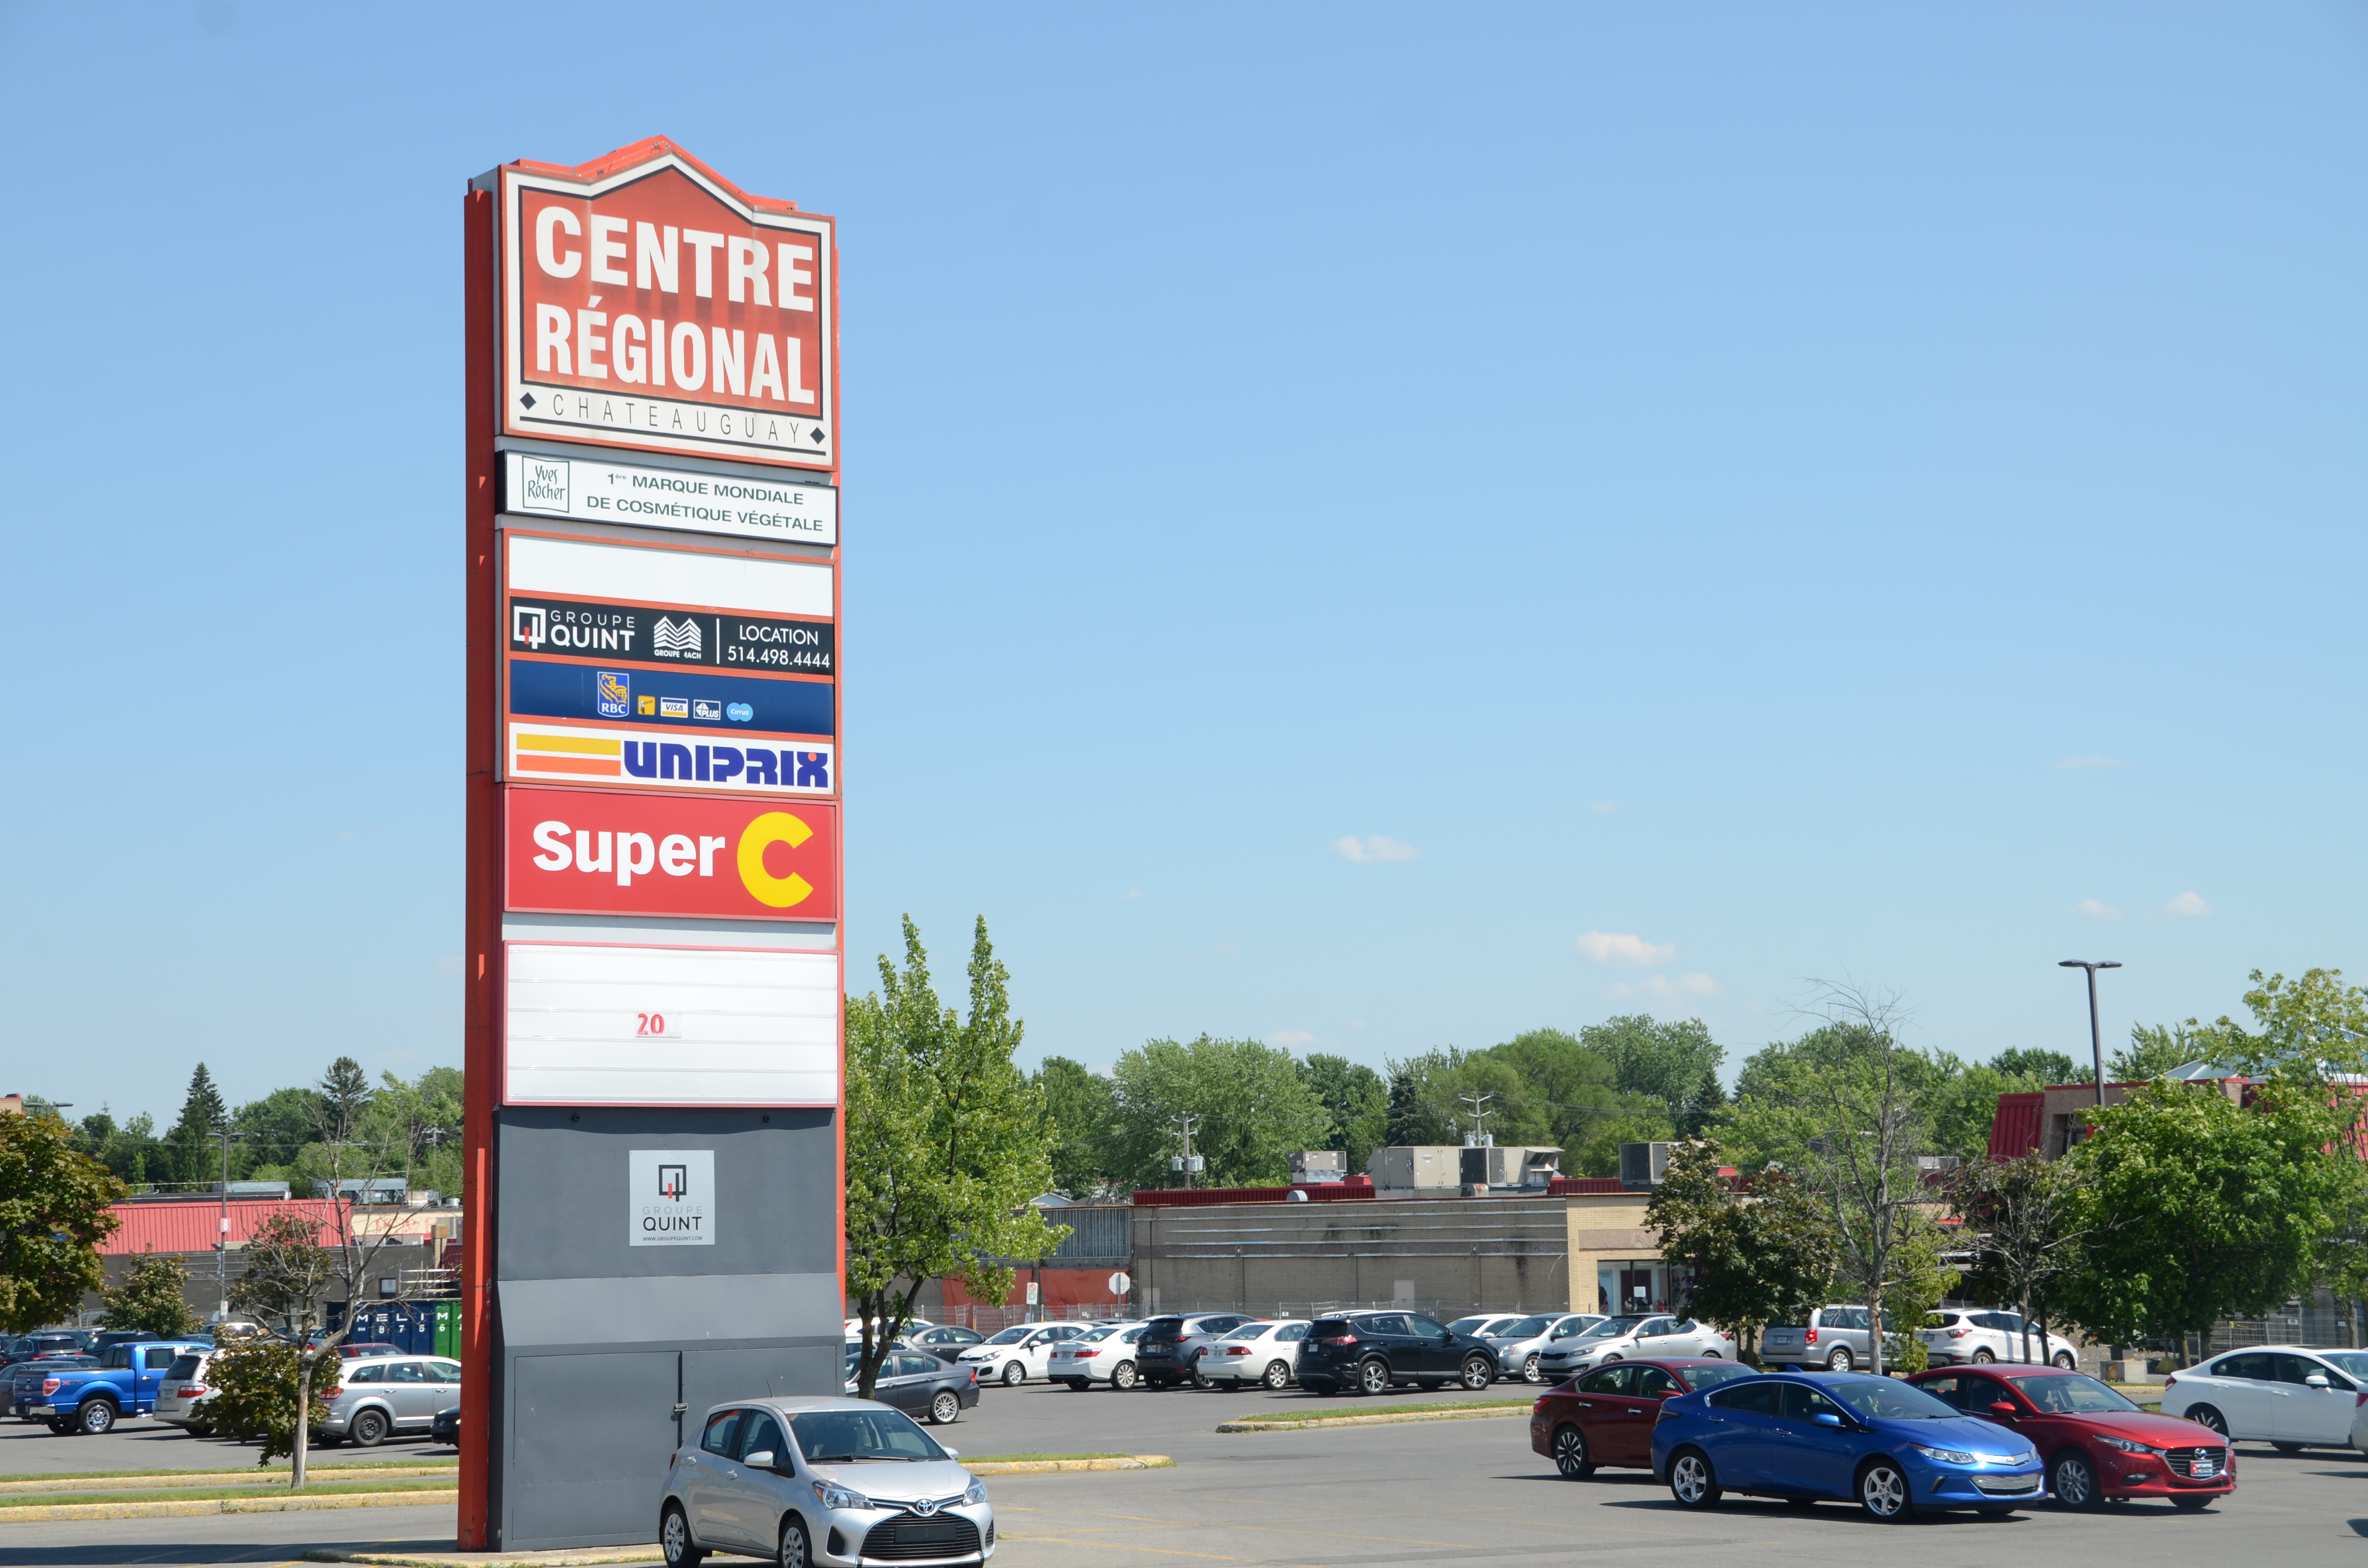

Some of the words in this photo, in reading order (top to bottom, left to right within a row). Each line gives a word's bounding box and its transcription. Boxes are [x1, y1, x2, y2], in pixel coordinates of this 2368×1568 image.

[536, 206, 813, 312] CENTRE
[536, 296, 814, 404] RÉGIONAL
[553, 394, 799, 442] CHATEAUGUAY
[535, 465, 558, 485] Yves
[528, 480, 566, 500] Rocher
[633, 475, 708, 495] MARQUE
[714, 484, 803, 505] MONDIALE
[587, 496, 610, 509] DE
[617, 499, 732, 522] COSMÉTIQUE
[737, 511, 823, 531] VÉGÉTALE
[550, 610, 635, 628] GROUPE
[550, 624, 635, 651] QUINT
[740, 625, 818, 646] LOCATION
[654, 649, 680, 658] GROUPE
[728, 646, 830, 668] 514.498.4444
[602, 703, 626, 714] RBC
[665, 704, 683, 712] VISA
[701, 710, 719, 718] PLUS
[624, 740, 828, 788] UNIPRIX
[532, 821, 725, 886] Super
[737, 811, 814, 908] C
[642, 1206, 703, 1214] GROUPE
[223, 1219, 228, 1231] 8
[643, 1216, 702, 1232] QUINT
